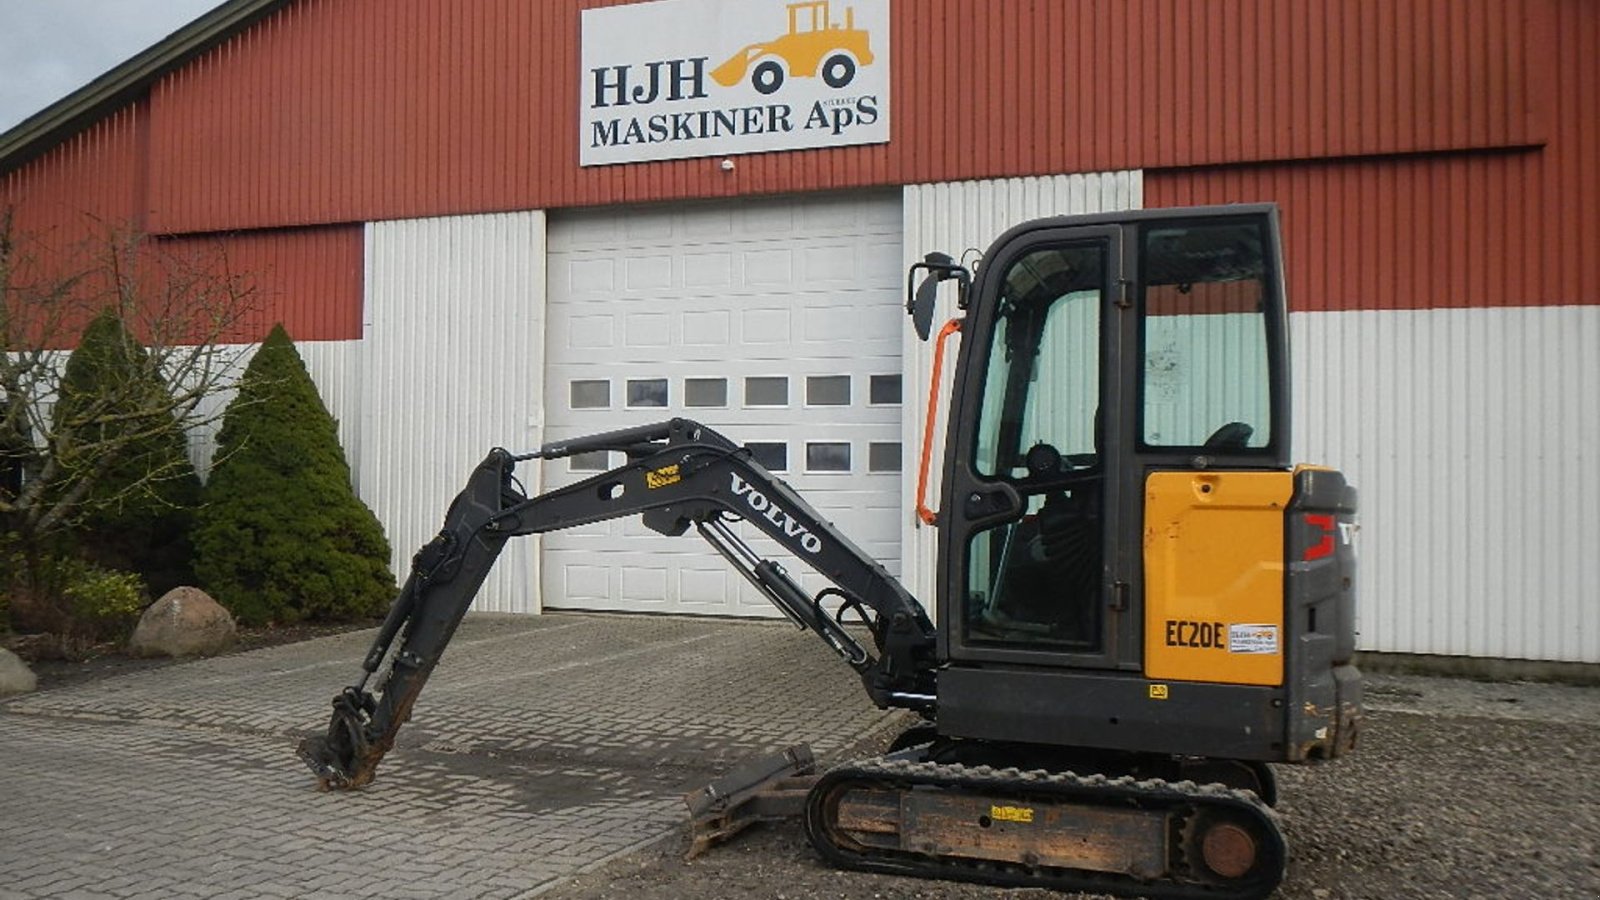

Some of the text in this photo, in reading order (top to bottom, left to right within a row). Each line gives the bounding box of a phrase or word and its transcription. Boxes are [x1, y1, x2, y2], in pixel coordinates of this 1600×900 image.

[591, 57, 708, 108] HJH
[591, 95, 878, 147] MASKINER ApS
[730, 471, 821, 553] VOLVO
[1166, 620, 1224, 648] EC20E
